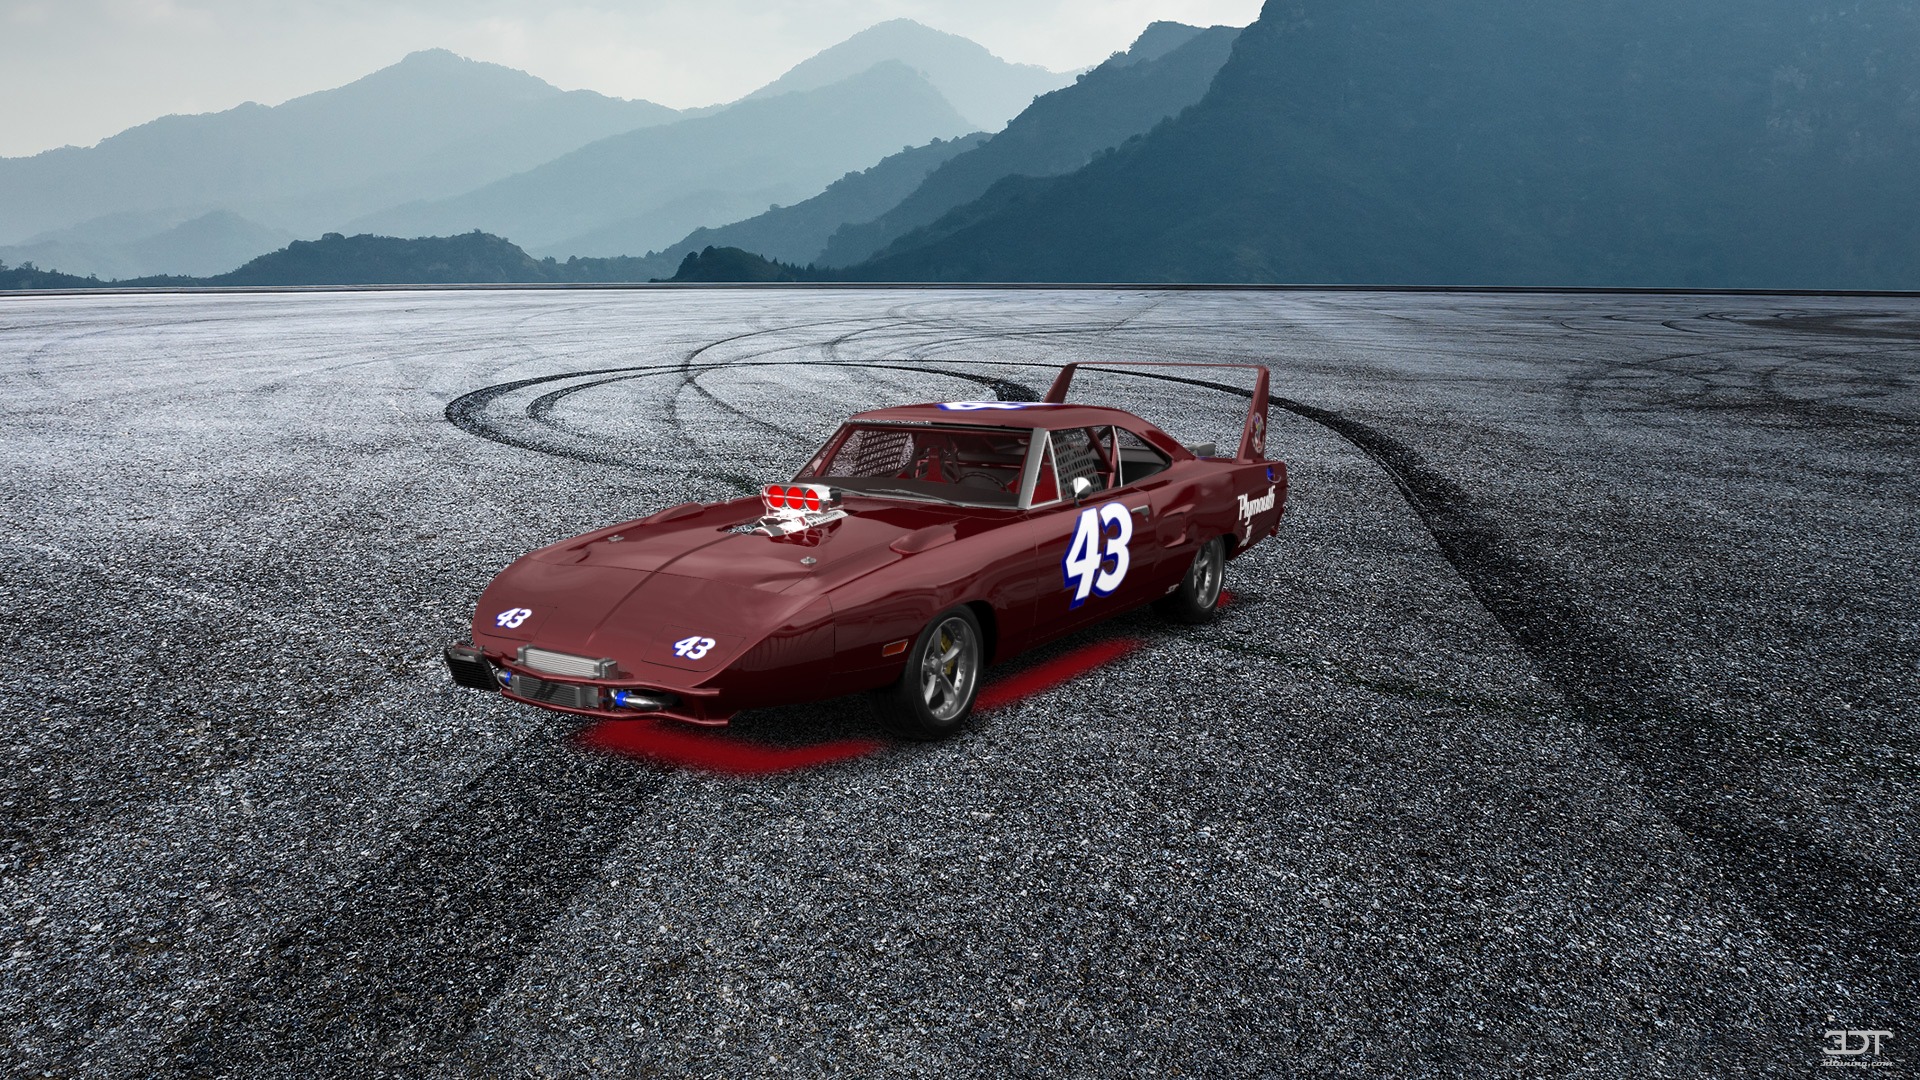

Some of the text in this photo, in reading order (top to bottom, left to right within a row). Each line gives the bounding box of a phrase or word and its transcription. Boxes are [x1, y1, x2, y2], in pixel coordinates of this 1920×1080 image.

[1061, 502, 1133, 611] 43
[495, 607, 532, 629] 43
[673, 636, 716, 660] 43
